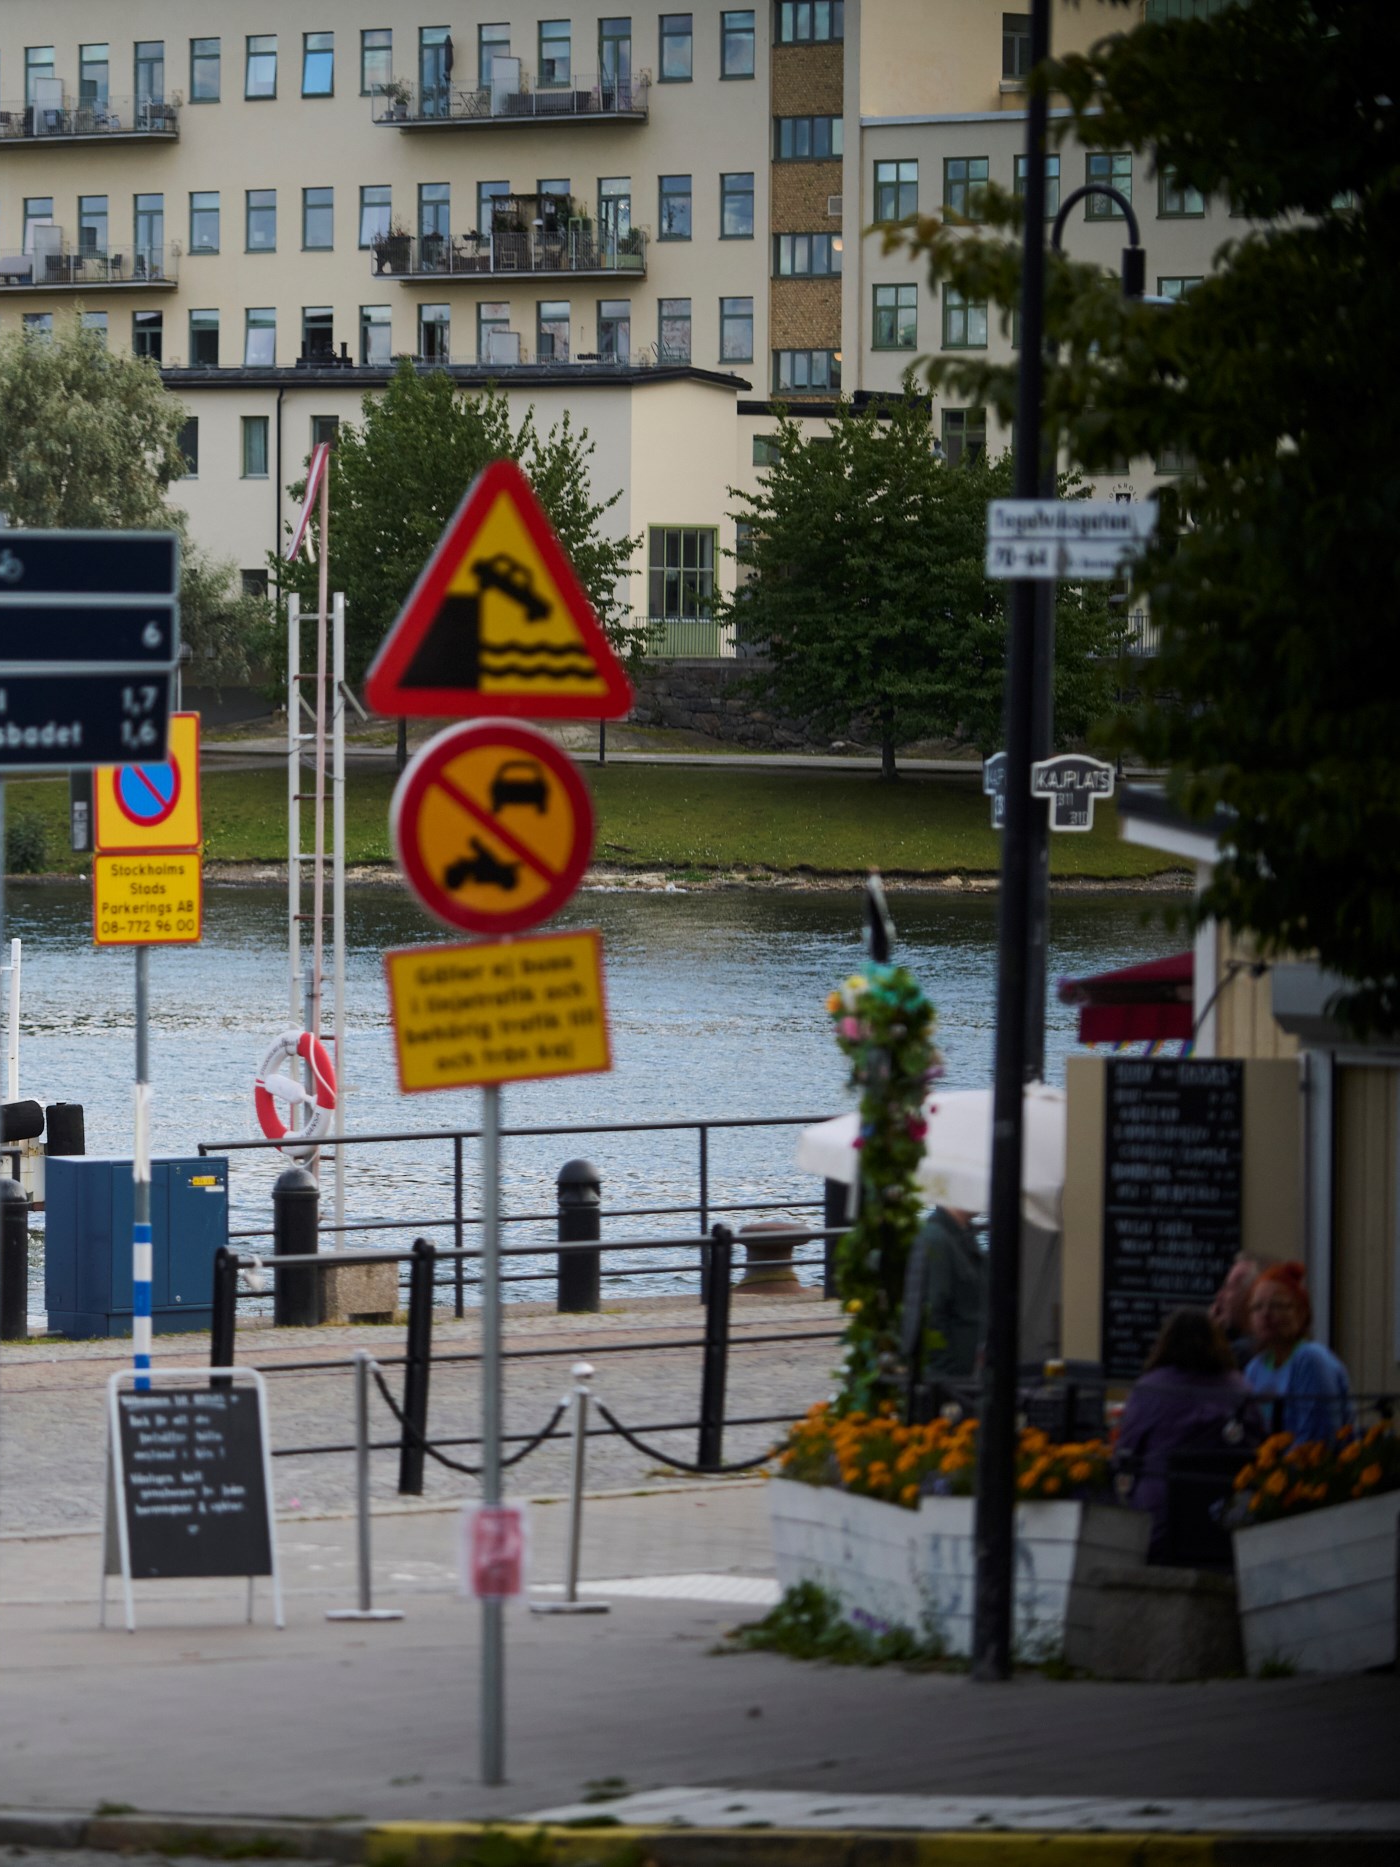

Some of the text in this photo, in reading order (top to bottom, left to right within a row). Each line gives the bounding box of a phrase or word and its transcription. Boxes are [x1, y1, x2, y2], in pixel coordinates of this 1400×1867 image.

[142, 620, 163, 649] 6
[121, 686, 158, 716] 1,7
[120, 721, 156, 748] 1,6
[1035, 769, 1110, 789] KAJPLATS
[110, 863, 185, 878] Stockholms
[129, 882, 167, 896] Stads
[101, 899, 194, 917] Parkerings AB
[101, 918, 195, 934] 08-772 96 00
[543, 981, 584, 1000] och
[500, 1014, 560, 1035] trafik
[568, 1008, 595, 1027] till
[435, 1040, 575, 1070] och från kaj
